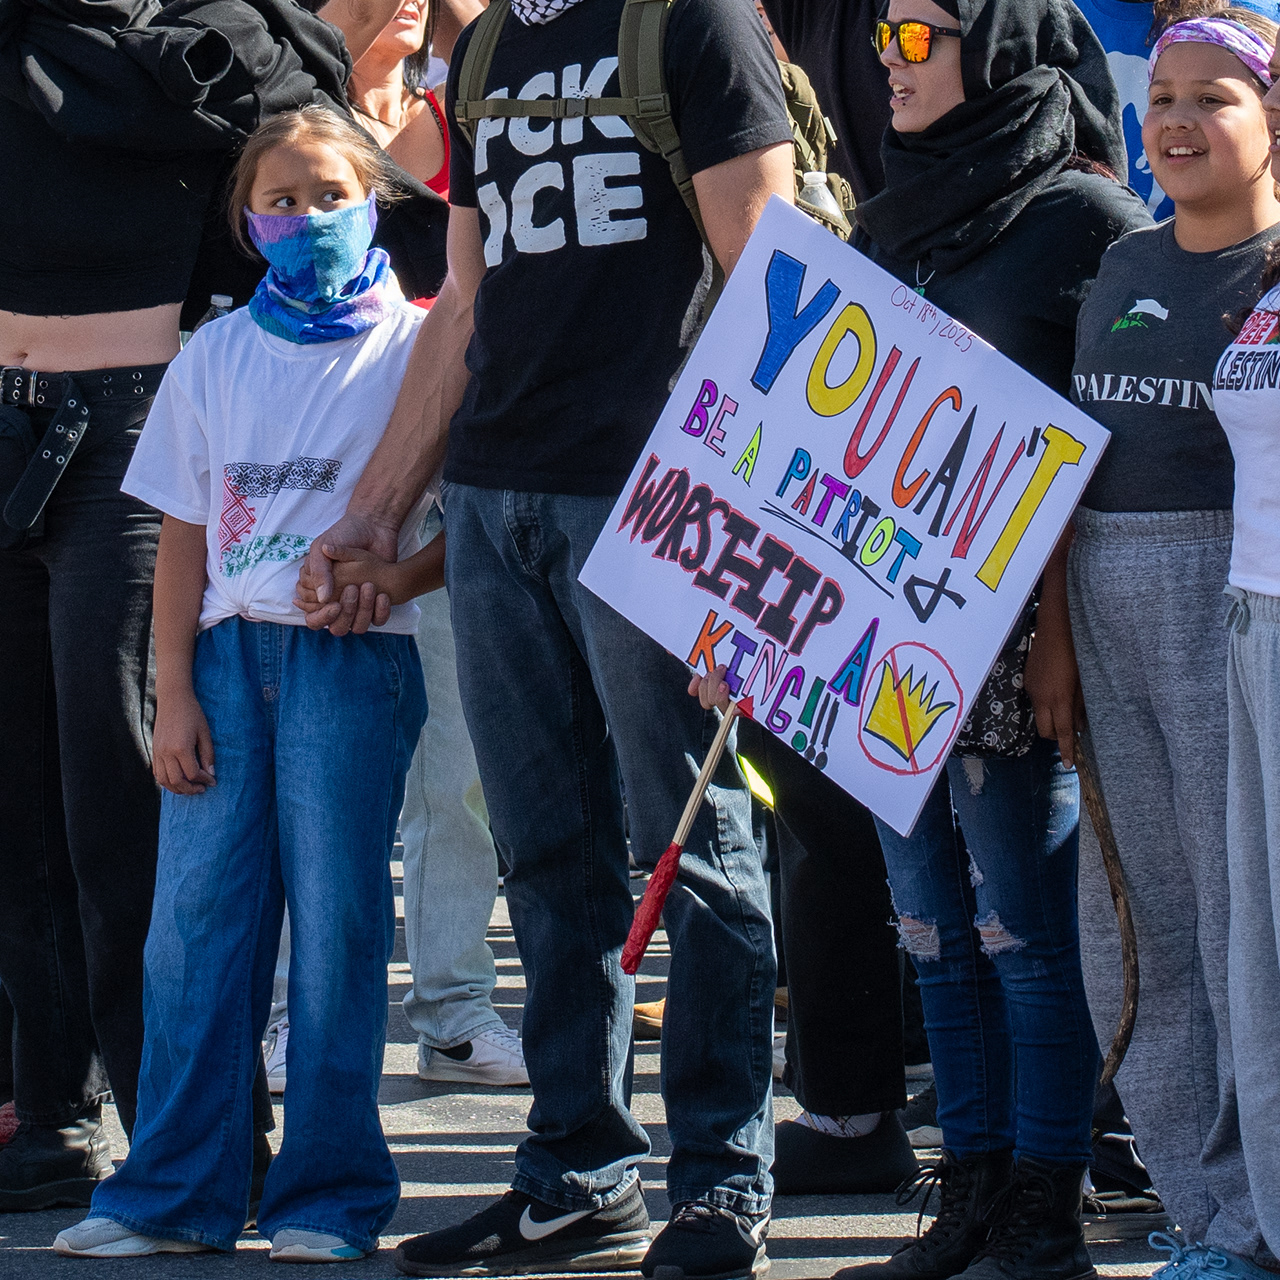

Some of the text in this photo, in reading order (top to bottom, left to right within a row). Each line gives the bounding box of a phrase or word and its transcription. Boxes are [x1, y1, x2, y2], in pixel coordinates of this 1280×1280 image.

[750, 249, 1086, 593] YOU CAN'T
[891, 285, 917, 314] Oct
[939, 317, 977, 353] 2025
[1073, 373, 1215, 411] PALESTIN
[616, 452, 880, 707] WORSHIP A
[679, 378, 739, 457] BE
[731, 420, 763, 488] A
[775, 447, 923, 583] PATRIOT
